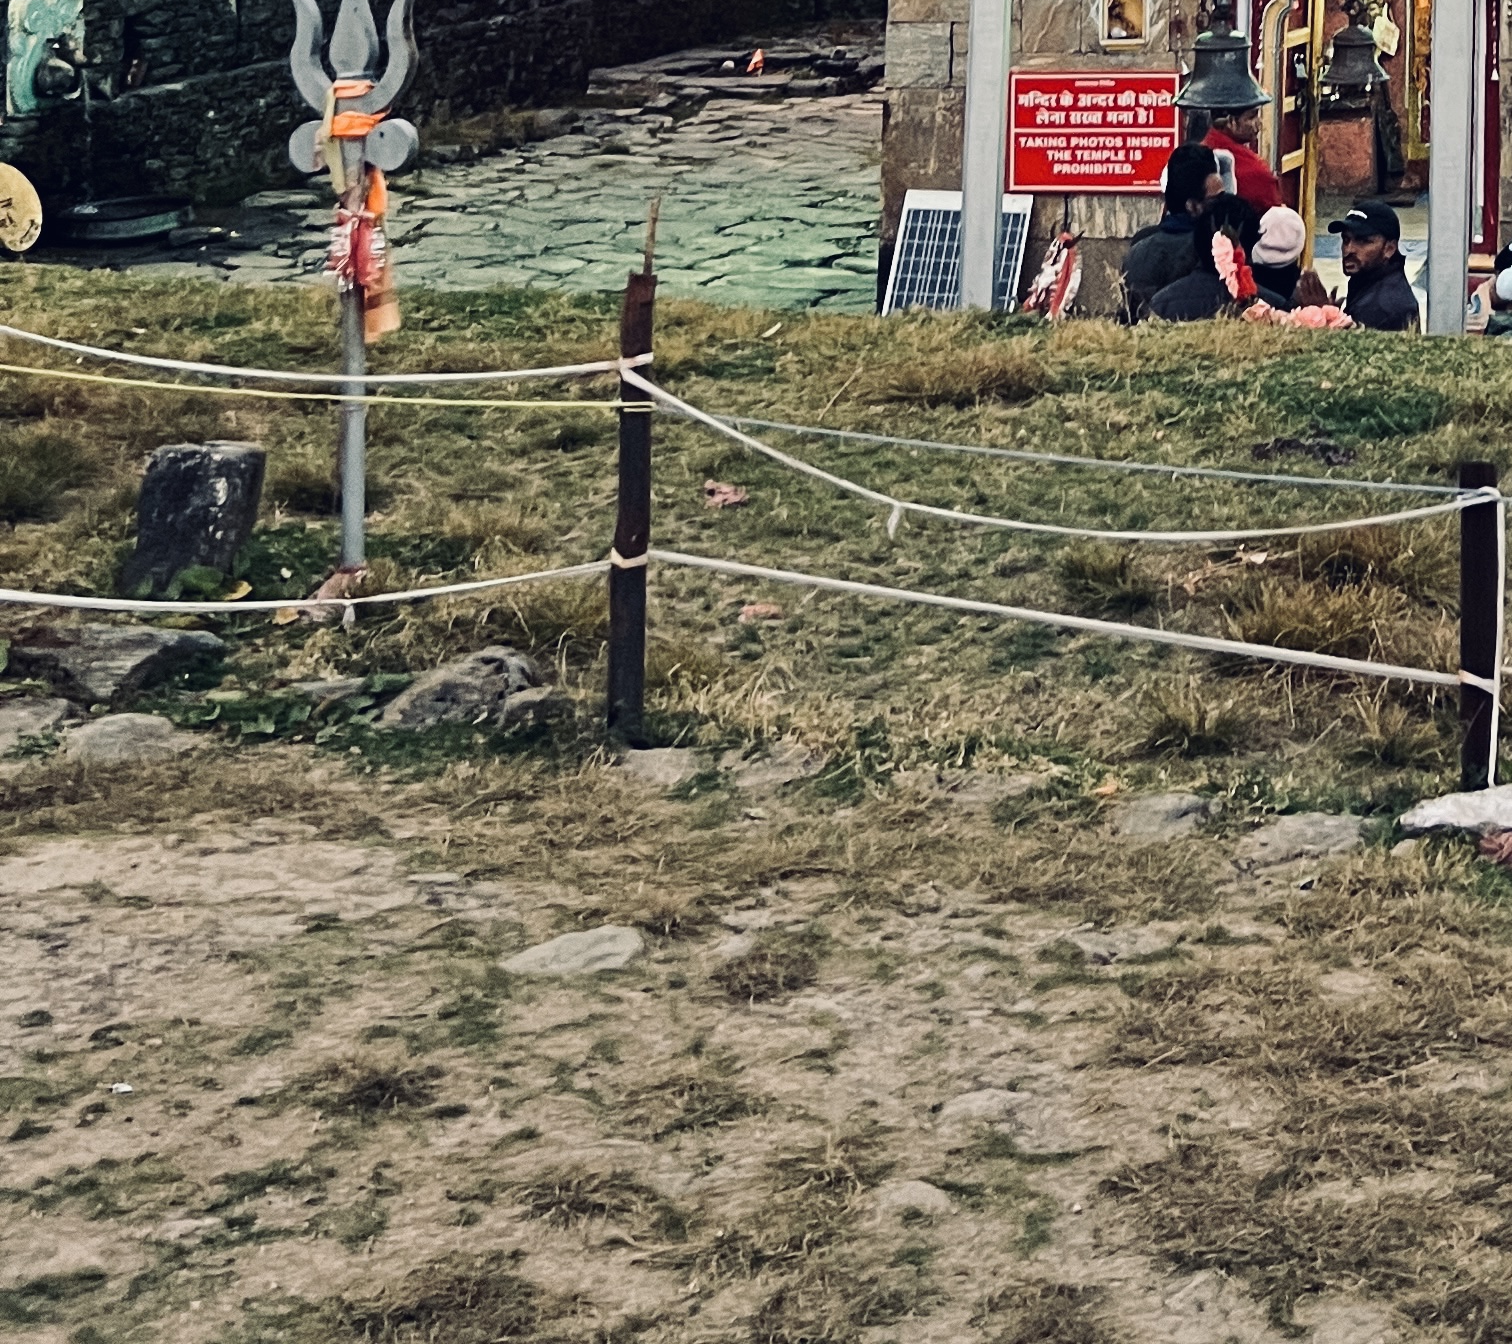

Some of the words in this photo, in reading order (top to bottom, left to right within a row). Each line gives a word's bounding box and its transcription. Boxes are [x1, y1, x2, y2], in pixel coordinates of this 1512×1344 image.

[1059, 90, 1074, 107] के
[1078, 92, 1115, 107] अन्दर
[1117, 90, 1136, 107] की
[1139, 89, 1173, 107] फोटो
[1036, 107, 1066, 124] लेना
[1106, 110, 1133, 124] मना
[1019, 136, 1067, 148] TAKING
[1070, 136, 1123, 148] PHOTOS
[1126, 136, 1170, 148] INSIDE
[1047, 150, 1072, 161] THE
[1075, 150, 1125, 161] TEMPLE
[1129, 150, 1142, 161] IS
